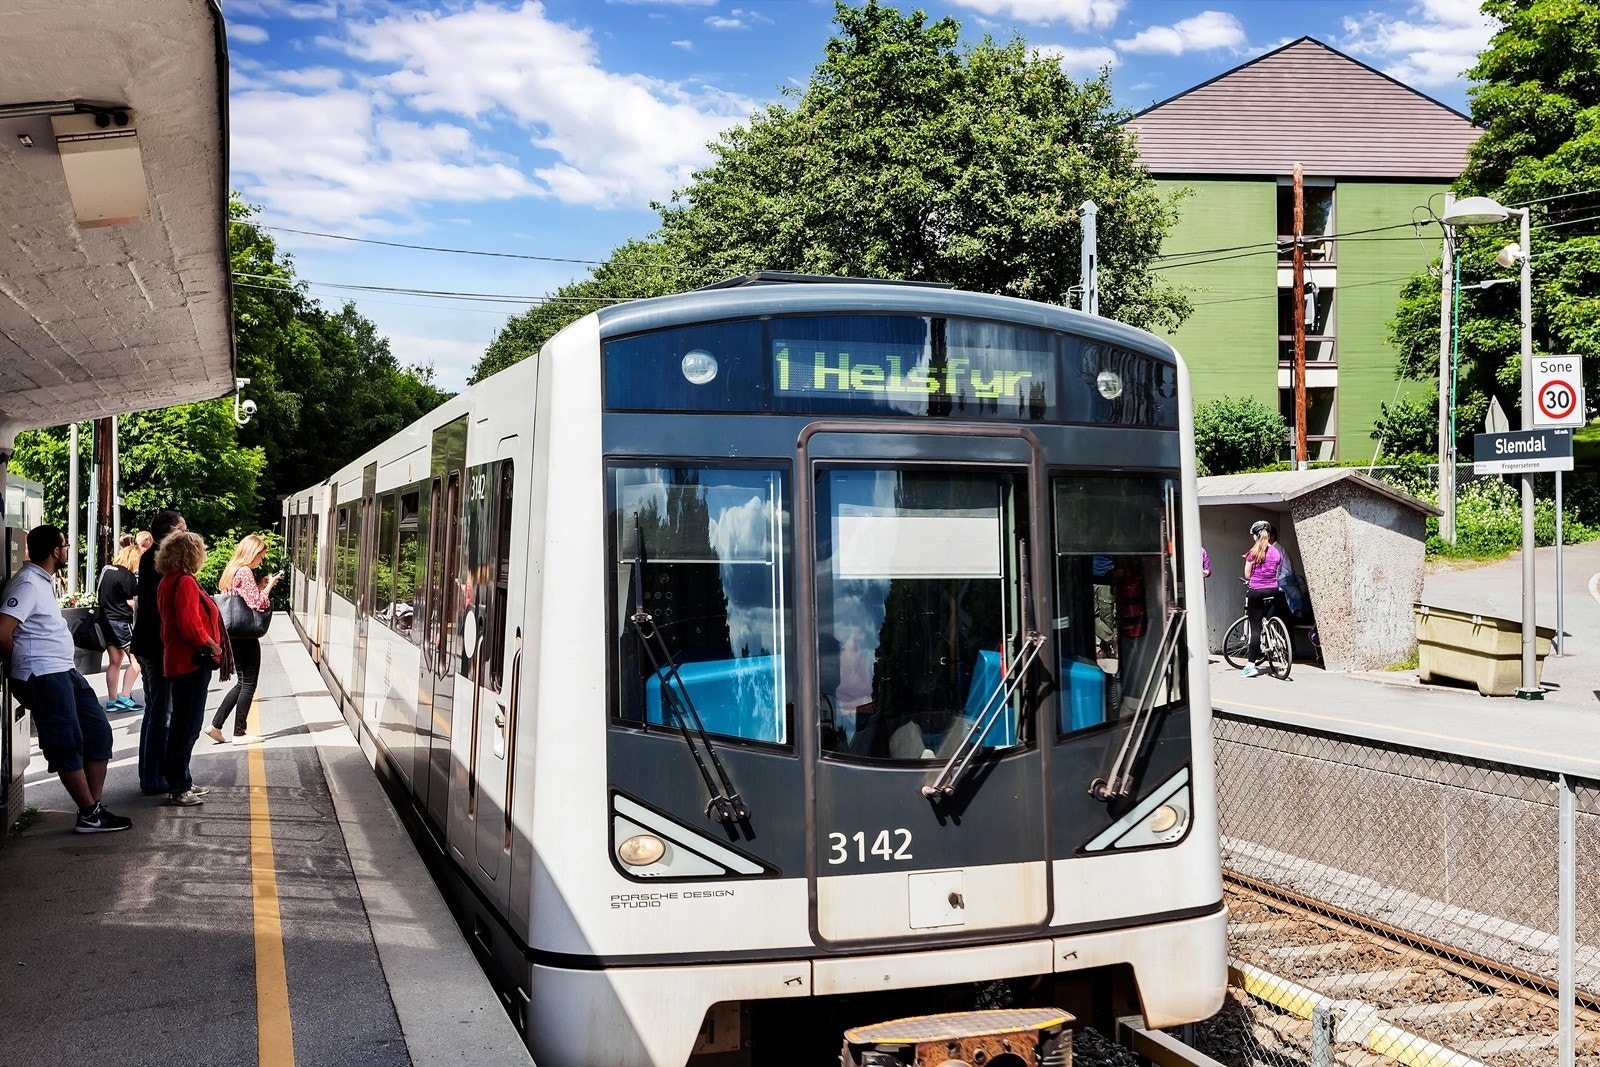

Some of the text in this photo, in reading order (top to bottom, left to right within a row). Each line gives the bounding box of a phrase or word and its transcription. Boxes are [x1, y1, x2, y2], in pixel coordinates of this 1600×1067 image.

[776, 348, 1032, 398] 1 Helsfyr
[1540, 361, 1572, 373] Sone
[1545, 390, 1570, 409] 30
[1495, 435, 1547, 455] Slemdal
[1501, 462, 1540, 470] Frognerseteren
[470, 474, 486, 500] 3142
[827, 828, 913, 865] 3142
[610, 890, 735, 902] PORSCHE DESIGN
[610, 901, 661, 909] STUDIO
